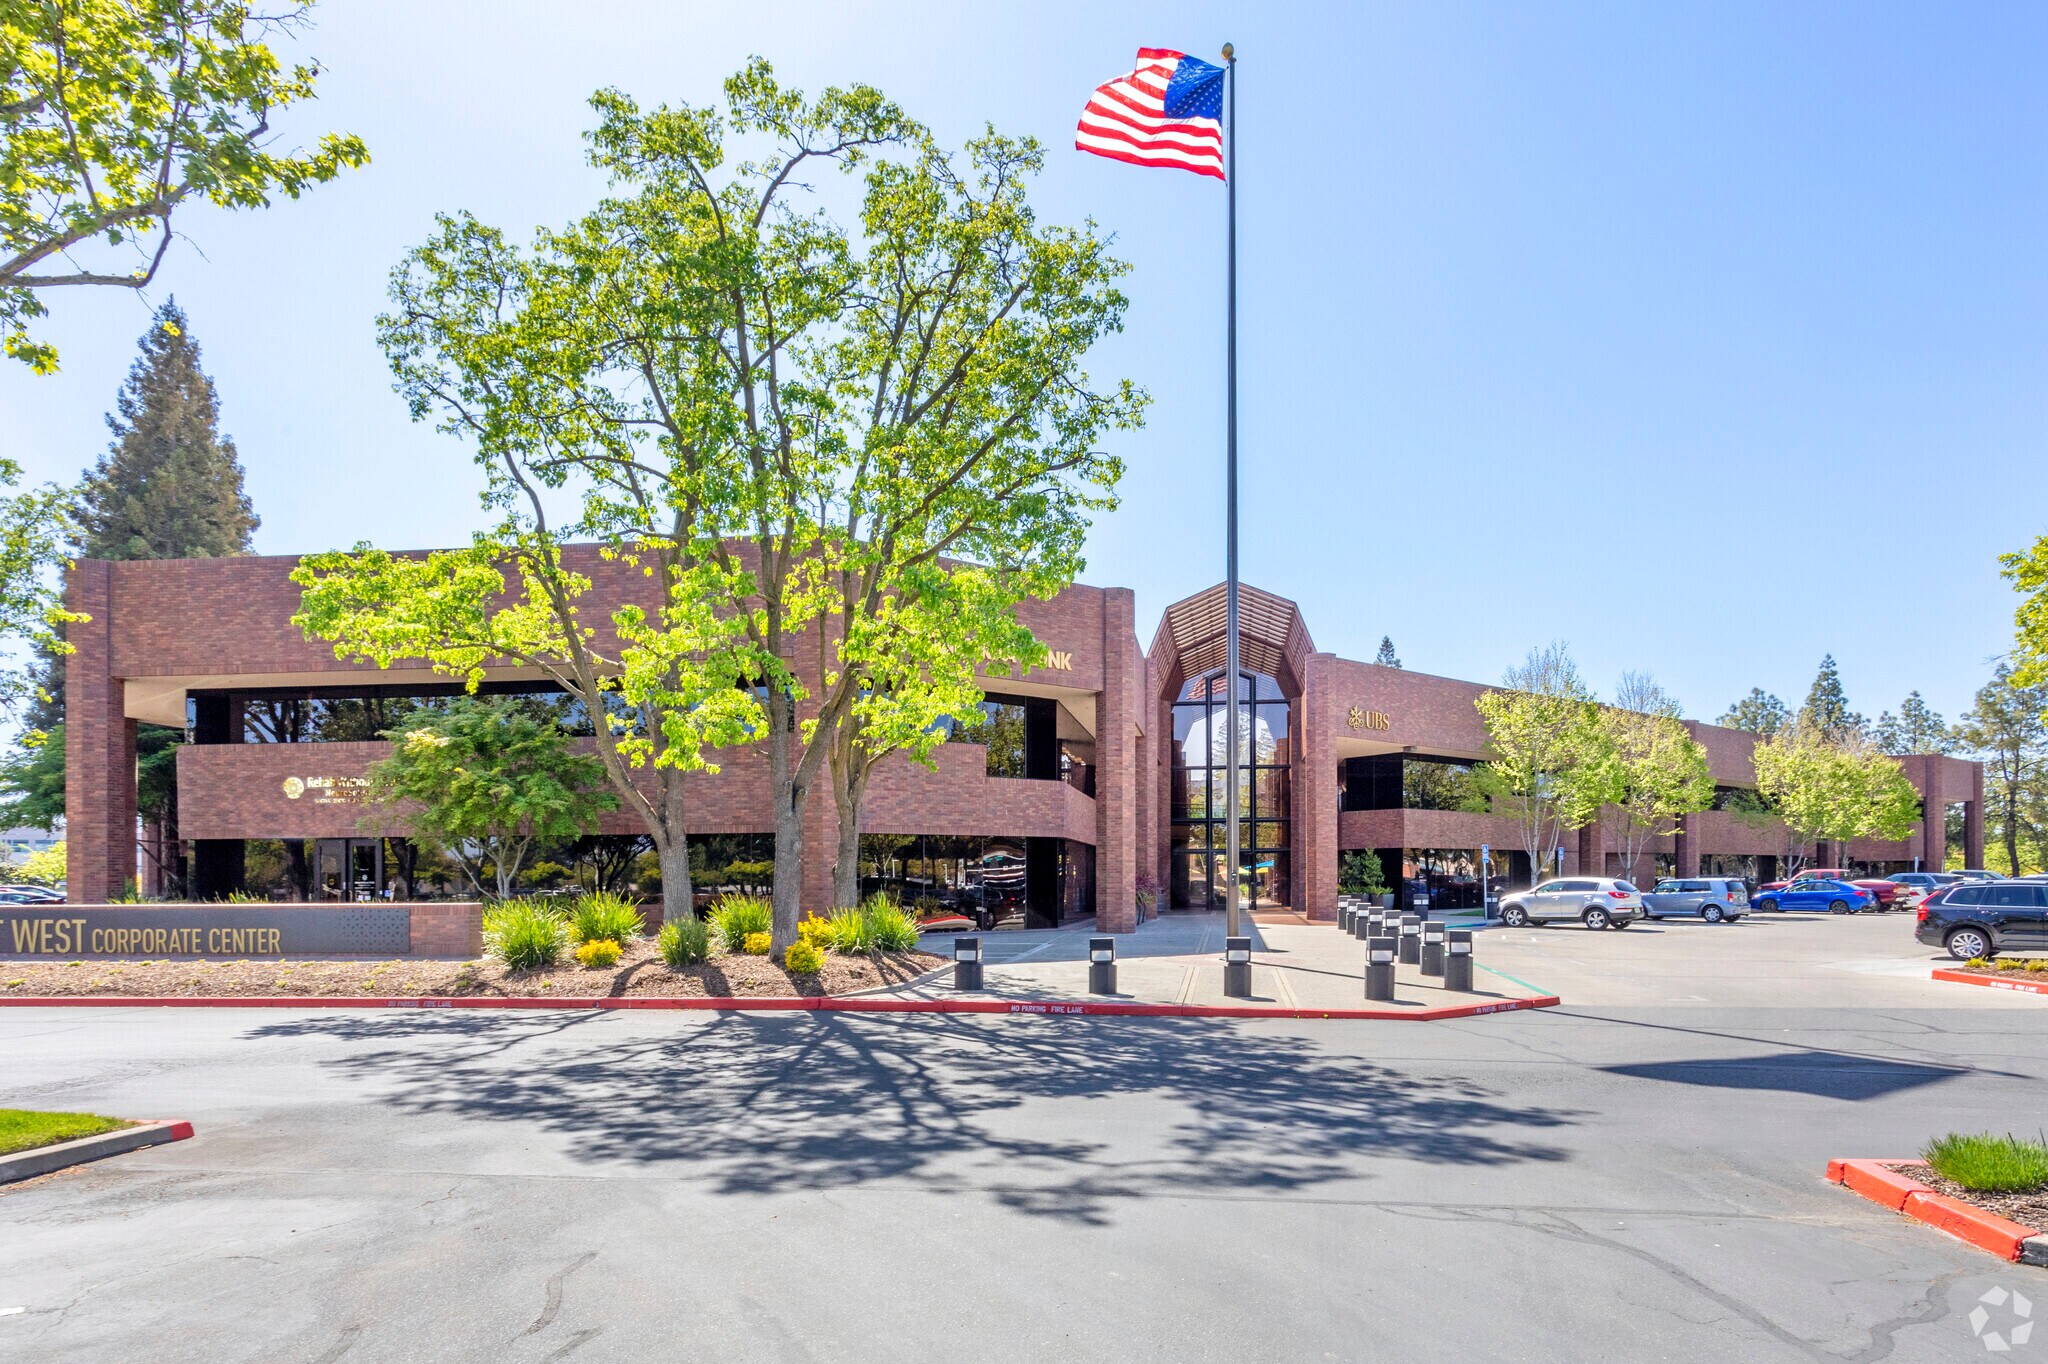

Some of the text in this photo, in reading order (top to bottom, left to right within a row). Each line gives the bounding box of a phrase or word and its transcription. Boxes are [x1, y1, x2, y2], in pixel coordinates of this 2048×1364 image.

[1365, 710, 1390, 731] UBS
[307, 776, 336, 788] Rehab
[11, 919, 87, 953] WEST
[91, 928, 202, 953] CORPORATE
[208, 928, 281, 953] CENTER
[423, 1000, 437, 1008] FIRE
[437, 1000, 452, 1008] LANE
[1021, 1005, 1046, 1013] PARKING
[1051, 1005, 1065, 1013] FIRE
[1067, 1006, 1083, 1014] LANE
